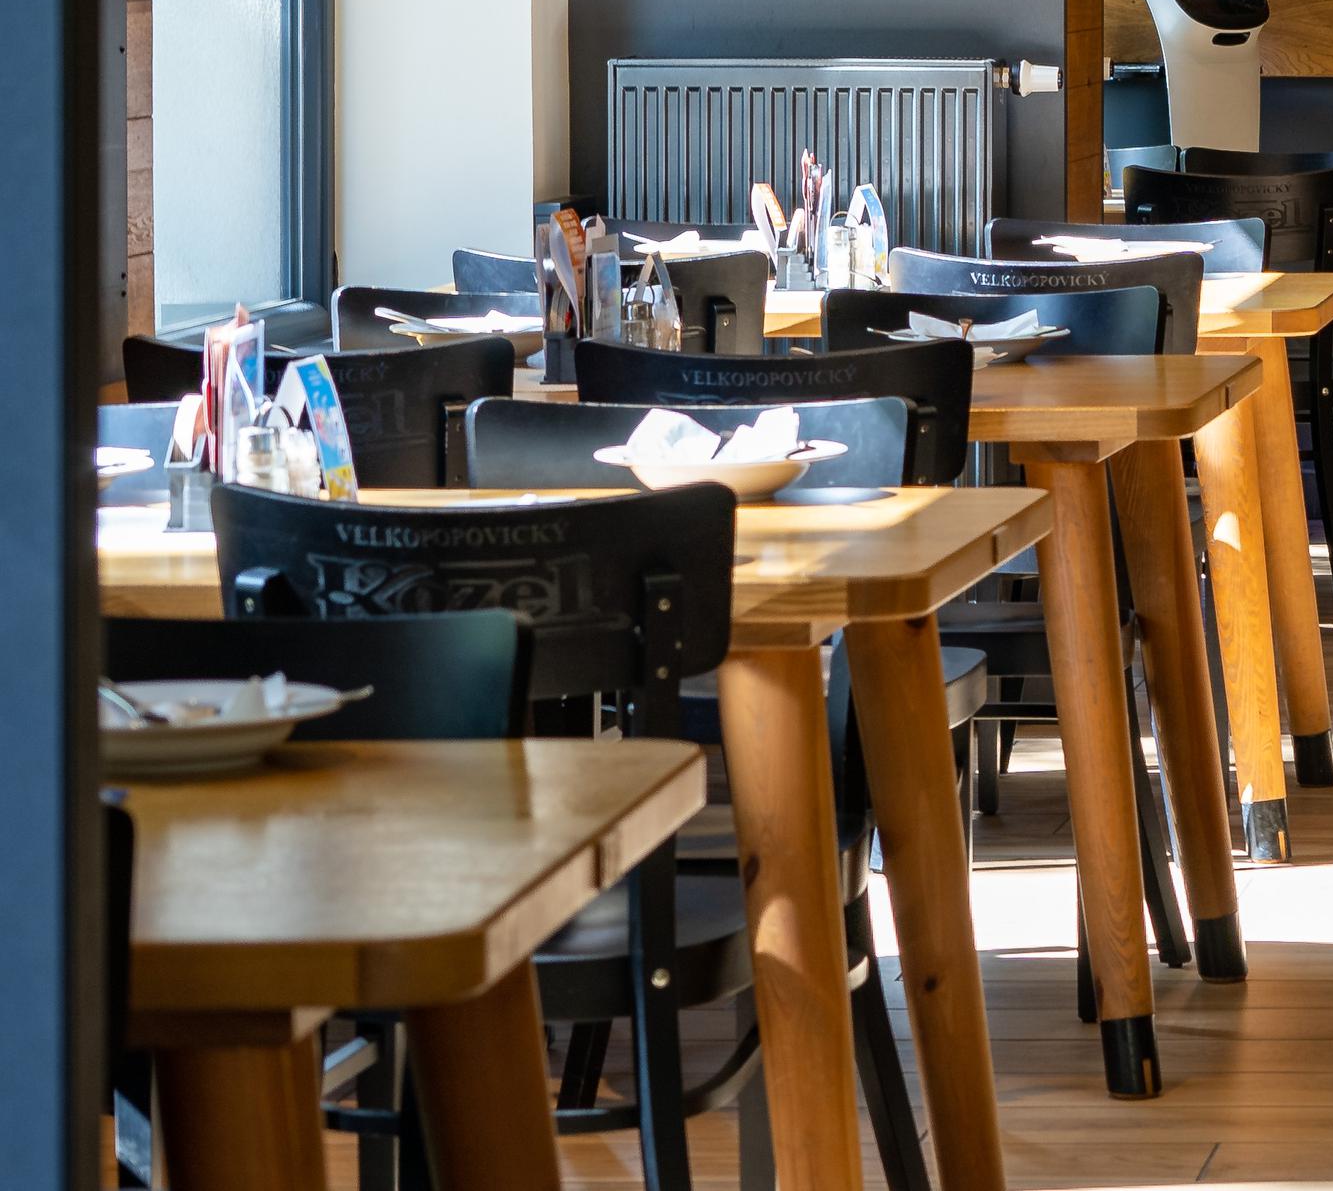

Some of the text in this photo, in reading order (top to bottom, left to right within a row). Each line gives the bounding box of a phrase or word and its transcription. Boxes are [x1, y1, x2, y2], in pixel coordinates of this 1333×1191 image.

[969, 270, 1111, 288] VELKOPOPOVICKÝ
[681, 364, 858, 388] VELKOPOPOVICKÝ
[335, 520, 570, 549] VELKOPOPOVICKÝ
